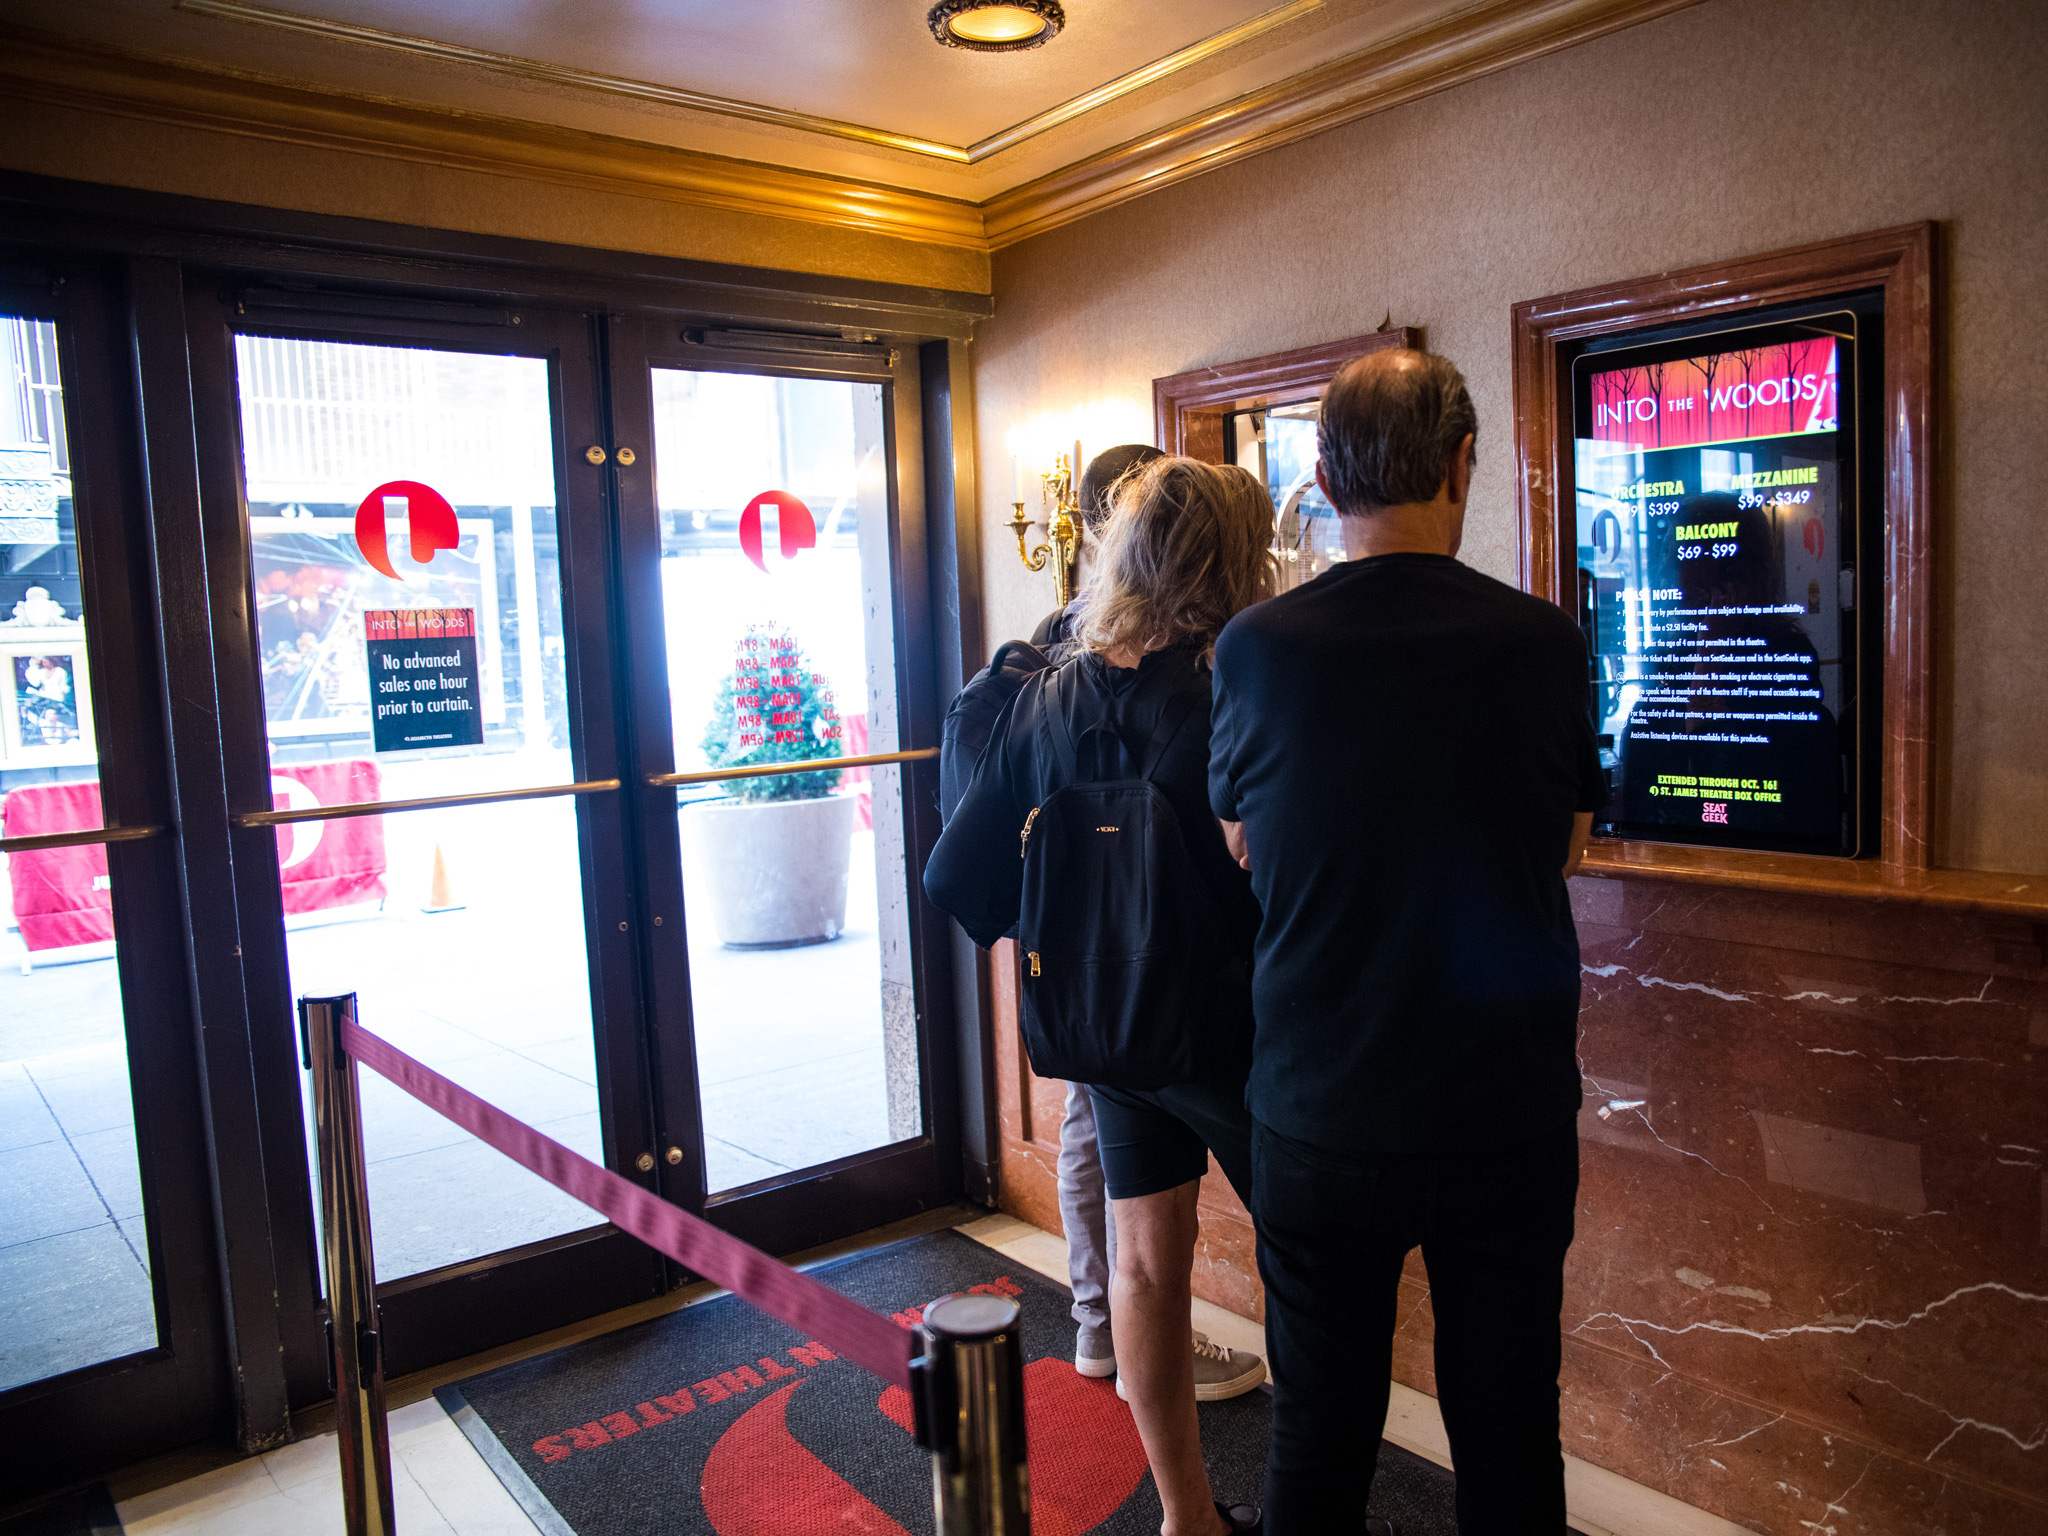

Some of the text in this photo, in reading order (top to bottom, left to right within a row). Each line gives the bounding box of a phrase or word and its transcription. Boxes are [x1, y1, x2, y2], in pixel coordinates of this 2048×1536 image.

[1598, 374, 1818, 426] INTO THE WOODS
[1731, 467, 1818, 490] MEZZANINE
[1610, 480, 1684, 500] ORCHESTRA
[1738, 494, 1763, 510] $99
[1775, 490, 1810, 507] $349
[1648, 502, 1679, 517] $399
[1676, 522, 1738, 540] BALCONY
[1677, 546, 1701, 560] $69
[1712, 543, 1736, 558] $99
[1616, 588, 1682, 602] PAS NOTE:
[1660, 608, 1666, 618] by
[1666, 608, 1697, 618] performance
[1698, 607, 1708, 615] and
[1718, 606, 1736, 616] subject
[1743, 605, 1762, 615] change
[1763, 605, 1773, 614] and
[1774, 604, 1805, 614] availability.
[372, 620, 400, 630] INTO
[420, 618, 464, 628] WOODS
[1666, 623, 1680, 632] $2.50
[1681, 622, 1697, 632] facility
[1698, 622, 1709, 631] fee.
[1666, 640, 1675, 648] age
[1676, 638, 1682, 646] of
[1705, 638, 1729, 648] permitted
[1737, 637, 1745, 646] the
[382, 650, 461, 670] No advanced
[1650, 654, 1662, 662] ticket
[1663, 654, 1672, 662] will
[1673, 654, 1679, 662] be
[1680, 654, 1702, 662] available
[1710, 654, 1746, 662] SeatGeek.com
[1747, 654, 1757, 662] and
[1758, 654, 1763, 662] in
[1764, 654, 1773, 662] the
[1774, 654, 1799, 662] SeatGeek
[379, 673, 468, 692] sales one hour
[1649, 672, 1674, 680] smoke-free
[1676, 672, 1710, 680] establishment.
[1719, 672, 1740, 682] smoking
[1748, 672, 1772, 680] electronic
[1773, 673, 1796, 682] cigarette
[1646, 687, 1659, 696] speak
[1660, 687, 1670, 695] with
[1712, 687, 1730, 695] theatre
[1731, 687, 1742, 695] staff
[1743, 687, 1748, 695] if
[1759, 688, 1772, 696] need
[1773, 688, 1799, 696] accessible
[1800, 689, 1820, 698] seating
[378, 696, 473, 719] prior to curtain.
[1647, 709, 1661, 718] safety
[1662, 709, 1667, 717] of
[1685, 711, 1704, 719] patrons,
[1733, 713, 1754, 721] weapons
[1765, 712, 1790, 721] permitted
[1791, 712, 1807, 720] inside
[1808, 712, 1818, 720] the
[1631, 731, 1649, 739] Assistive
[1650, 731, 1670, 741] listening
[1671, 732, 1688, 740] devices
[1698, 733, 1720, 741] available
[1721, 733, 1729, 741] for
[1740, 734, 1769, 744] production.
[1658, 775, 1778, 790] EXTENDED THROUGH OCT. 16!
[1660, 787, 1781, 802] ST. JAMES THEATRE BOX OFFICE
[1703, 802, 1727, 813] SEAT
[1702, 813, 1728, 824] GEEK
[532, 1355, 798, 1464] THEATERS
